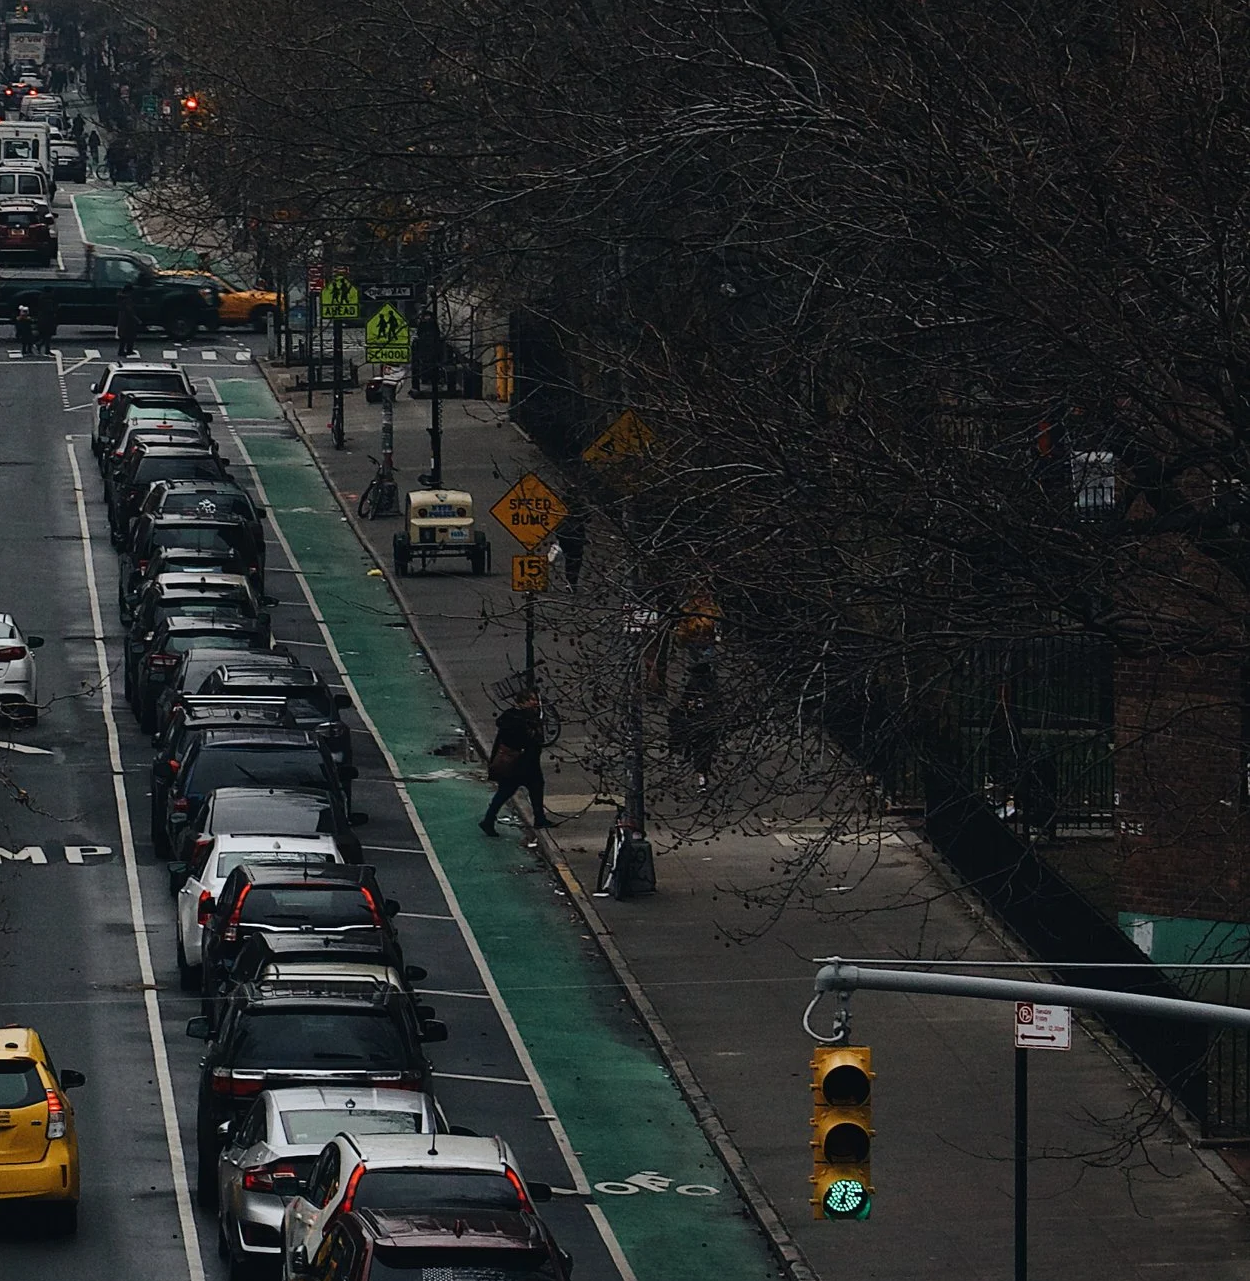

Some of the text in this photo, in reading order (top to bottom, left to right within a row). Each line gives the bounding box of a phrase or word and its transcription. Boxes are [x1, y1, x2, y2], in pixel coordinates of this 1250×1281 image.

[325, 306, 356, 316] AHEAD
[368, 349, 409, 360] SCHOOL
[509, 498, 551, 510] SPEED
[511, 513, 549, 526] BUMP
[519, 559, 542, 578] 15
